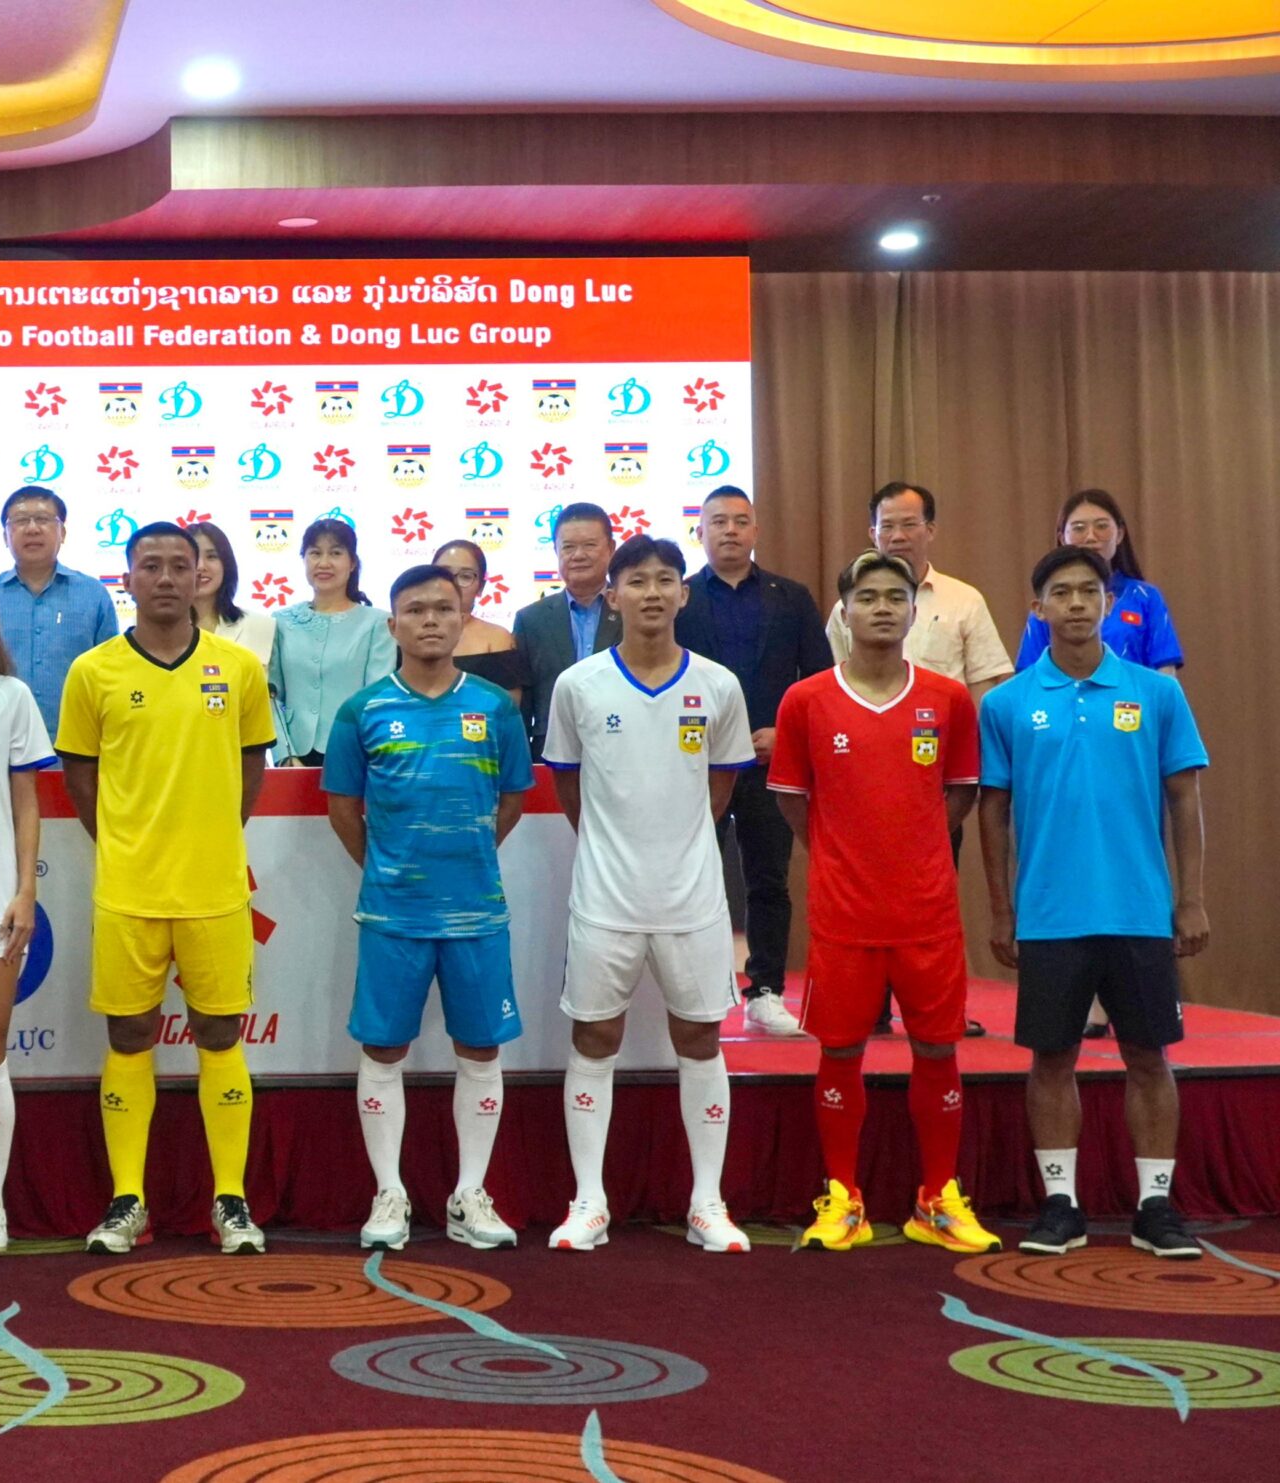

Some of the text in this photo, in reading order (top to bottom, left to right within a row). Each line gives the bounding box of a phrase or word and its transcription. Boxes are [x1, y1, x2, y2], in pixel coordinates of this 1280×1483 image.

[292, 284, 352, 304] ແລະ
[509, 278, 575, 309] Dong
[585, 278, 633, 303] Luc
[21, 324, 134, 348] Football
[143, 324, 292, 347] Federation
[300, 323, 322, 346] &
[331, 323, 401, 349] Dong
[410, 323, 460, 345] Luc
[469, 322, 552, 348] Group
